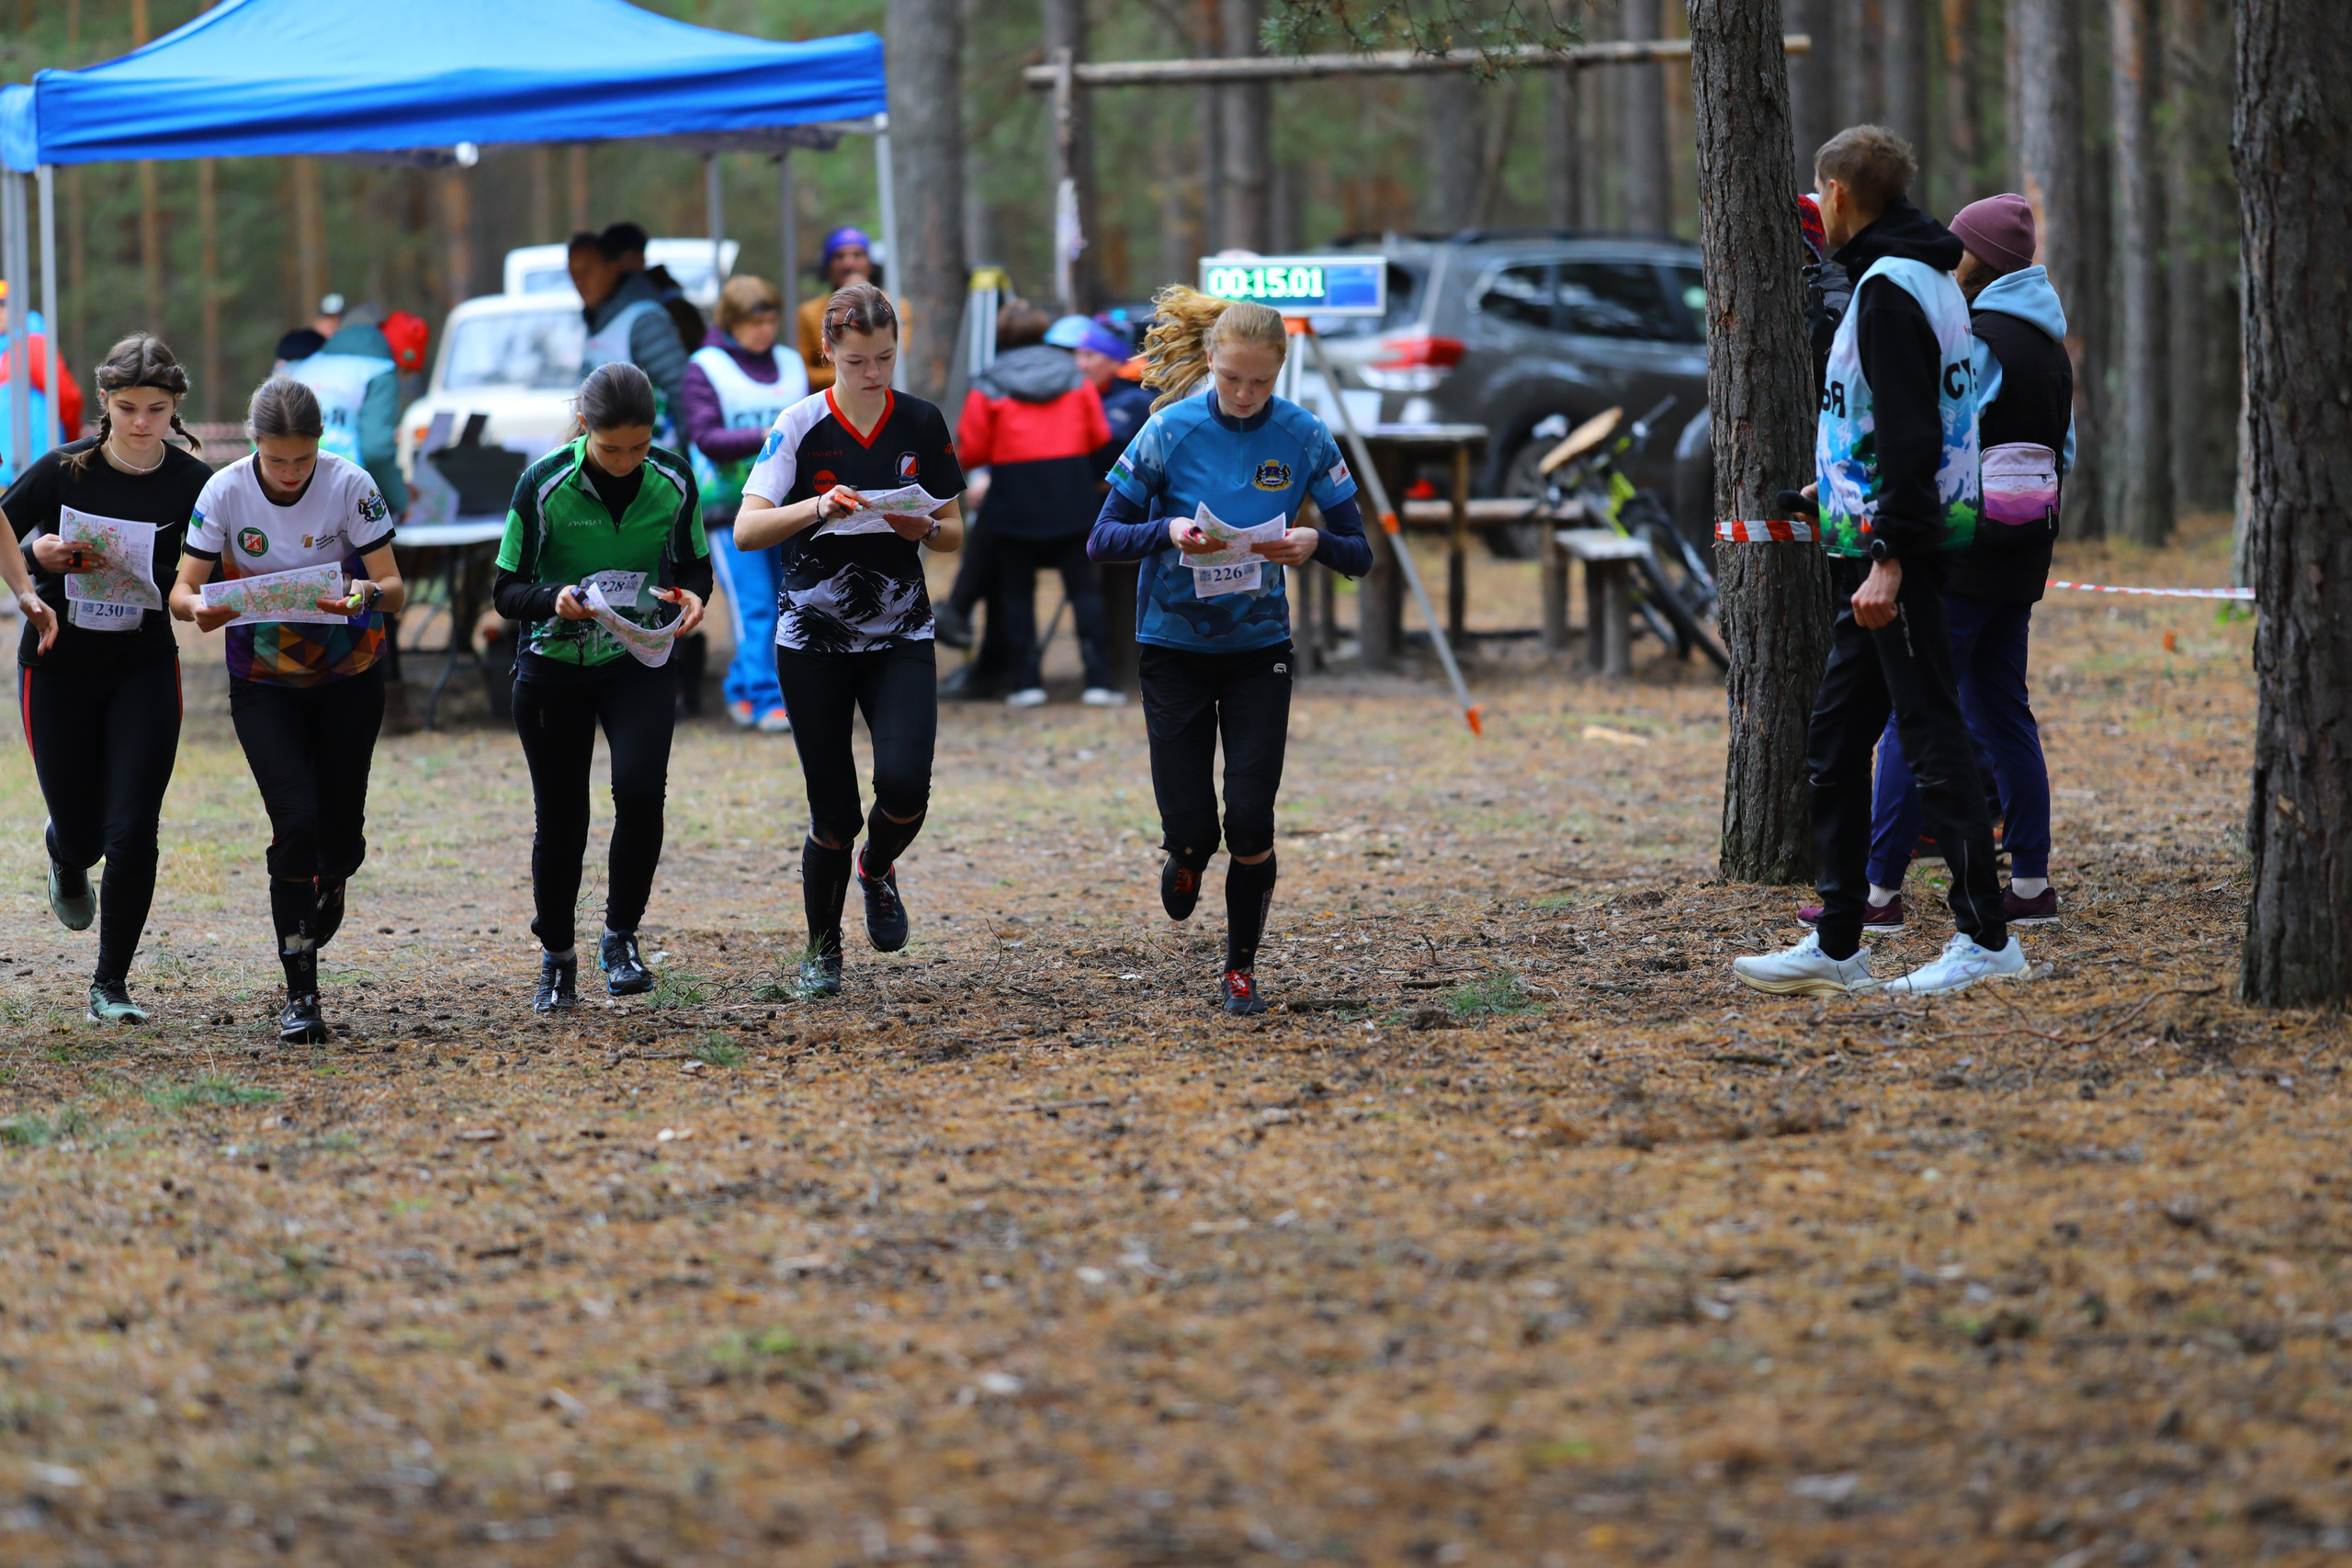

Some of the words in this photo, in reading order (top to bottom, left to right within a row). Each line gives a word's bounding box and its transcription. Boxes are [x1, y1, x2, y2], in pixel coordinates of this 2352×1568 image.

[1214, 565, 1243, 581] 226
[600, 581, 625, 592] 228
[95, 603, 125, 617] 230
